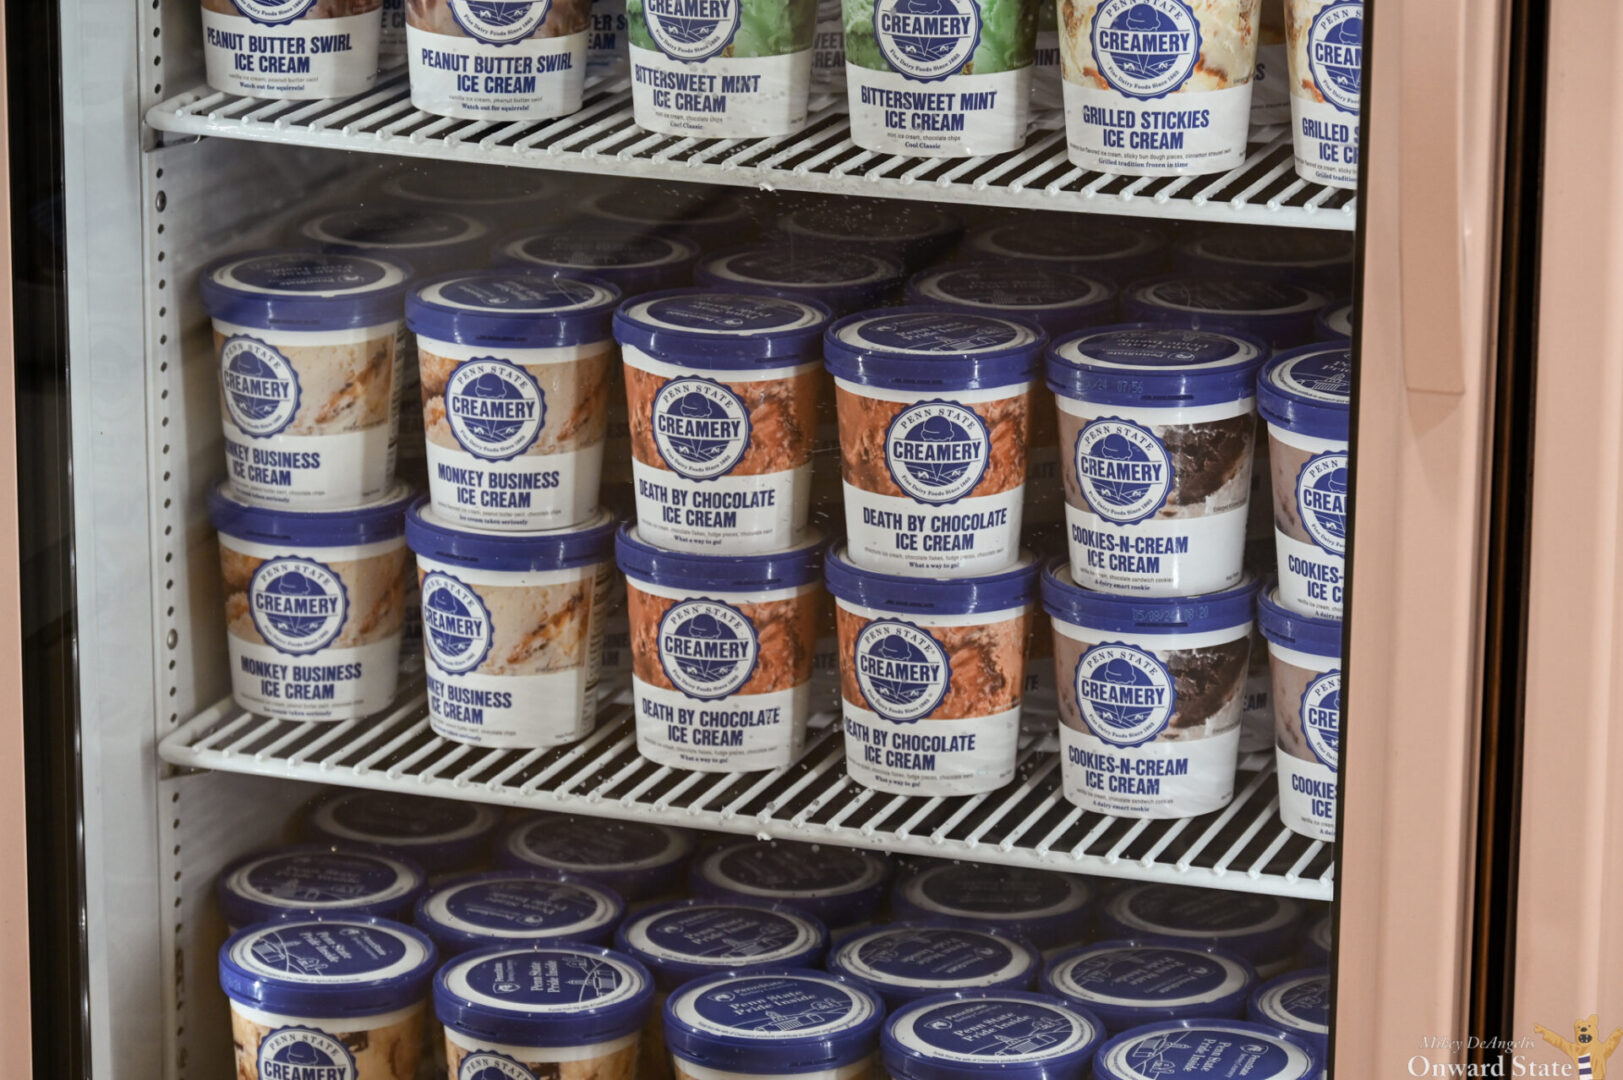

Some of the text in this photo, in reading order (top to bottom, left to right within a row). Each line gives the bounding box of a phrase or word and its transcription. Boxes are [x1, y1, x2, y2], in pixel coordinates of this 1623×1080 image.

[649, 0, 731, 19] CREAMERY
[1321, 8, 1349, 31] PENN
[882, 14, 971, 36] CREAMERY
[207, 27, 353, 54] PEANUT BUTTER SWIRL
[1100, 30, 1190, 53] CREAMERY
[235, 53, 311, 73] ICE CREAM
[422, 48, 573, 74] PEANUT BUTTER SWIRL
[457, 74, 537, 94] ICE CREAM
[635, 64, 762, 94] BITTERSWEET MINT
[653, 89, 727, 113] ICE CREAM
[861, 85, 998, 111] BITTERSWEET MINT
[885, 110, 965, 132] ICE CREAM
[1083, 105, 1210, 131] GRILLED STICKIES
[1302, 117, 1349, 143] GRILLED
[1103, 128, 1184, 151] ICE CREAM
[1319, 142, 1339, 162] ICE
[1099, 158, 1117, 167] Grilled
[1118, 160, 1145, 168] tradition
[247, 345, 282, 370] STATE
[224, 370, 289, 398] CREAMERY
[456, 366, 529, 390] PENN STATE
[452, 396, 536, 419] CREAMERY
[663, 385, 734, 409] PENN STATE
[658, 414, 741, 439] CREAMERY
[901, 408, 976, 431] PENN STATE
[1085, 425, 1155, 451] PENN STATE
[252, 448, 321, 469] BUSINESS
[893, 441, 981, 462] CREAMERY
[232, 459, 292, 487] ICE CREAM
[438, 462, 560, 490] MONKEY BUSINESS
[1080, 456, 1162, 482] CREAMERY
[1309, 458, 1338, 479] PENN
[457, 486, 531, 509] ICE CREAM
[640, 478, 776, 509] DEATH BY CHOCOLATE
[1303, 488, 1346, 514] CREA
[662, 505, 682, 525] ICE
[685, 509, 737, 529] CREAM
[863, 507, 1008, 533] DEATH BY CHOCOLATE
[896, 532, 975, 552] ICE CREAM
[1072, 524, 1189, 555] COOKIES-N-CREAM
[1087, 549, 1160, 574] ICE CREAM
[261, 564, 331, 586] PENN STATE
[1307, 580, 1327, 601] ICE
[255, 592, 338, 615] CREAMERY
[424, 605, 482, 638] CREAMERY
[669, 605, 743, 630] PENN STATE
[665, 635, 749, 659] CREAMERY
[864, 627, 933, 652] PENN STATE
[241, 655, 362, 683] MONKEY BUSINESS
[860, 654, 941, 682] CREAMERY
[1087, 650, 1158, 676] PENN STATE
[261, 679, 335, 701] ICE CREAM
[448, 684, 512, 710] BUSINESS
[1081, 679, 1165, 706] CREAMERY
[443, 700, 483, 726] CREAM
[642, 697, 780, 729] DEATH BY CHOCOLATE
[668, 724, 743, 747] ICE CREAM
[872, 727, 888, 748] BY
[892, 733, 976, 753] CHOCOLATE
[864, 743, 936, 772] ICE CREAM
[1068, 745, 1189, 776] COOKIES-N-CREAM
[1085, 770, 1105, 791] ICE
[1108, 774, 1160, 797] CREAM
[1311, 798, 1333, 819] ICE
[270, 1033, 339, 1056] PENN STATE
[264, 1060, 346, 1080] CREAMERY
[465, 1058, 489, 1074] PENN
